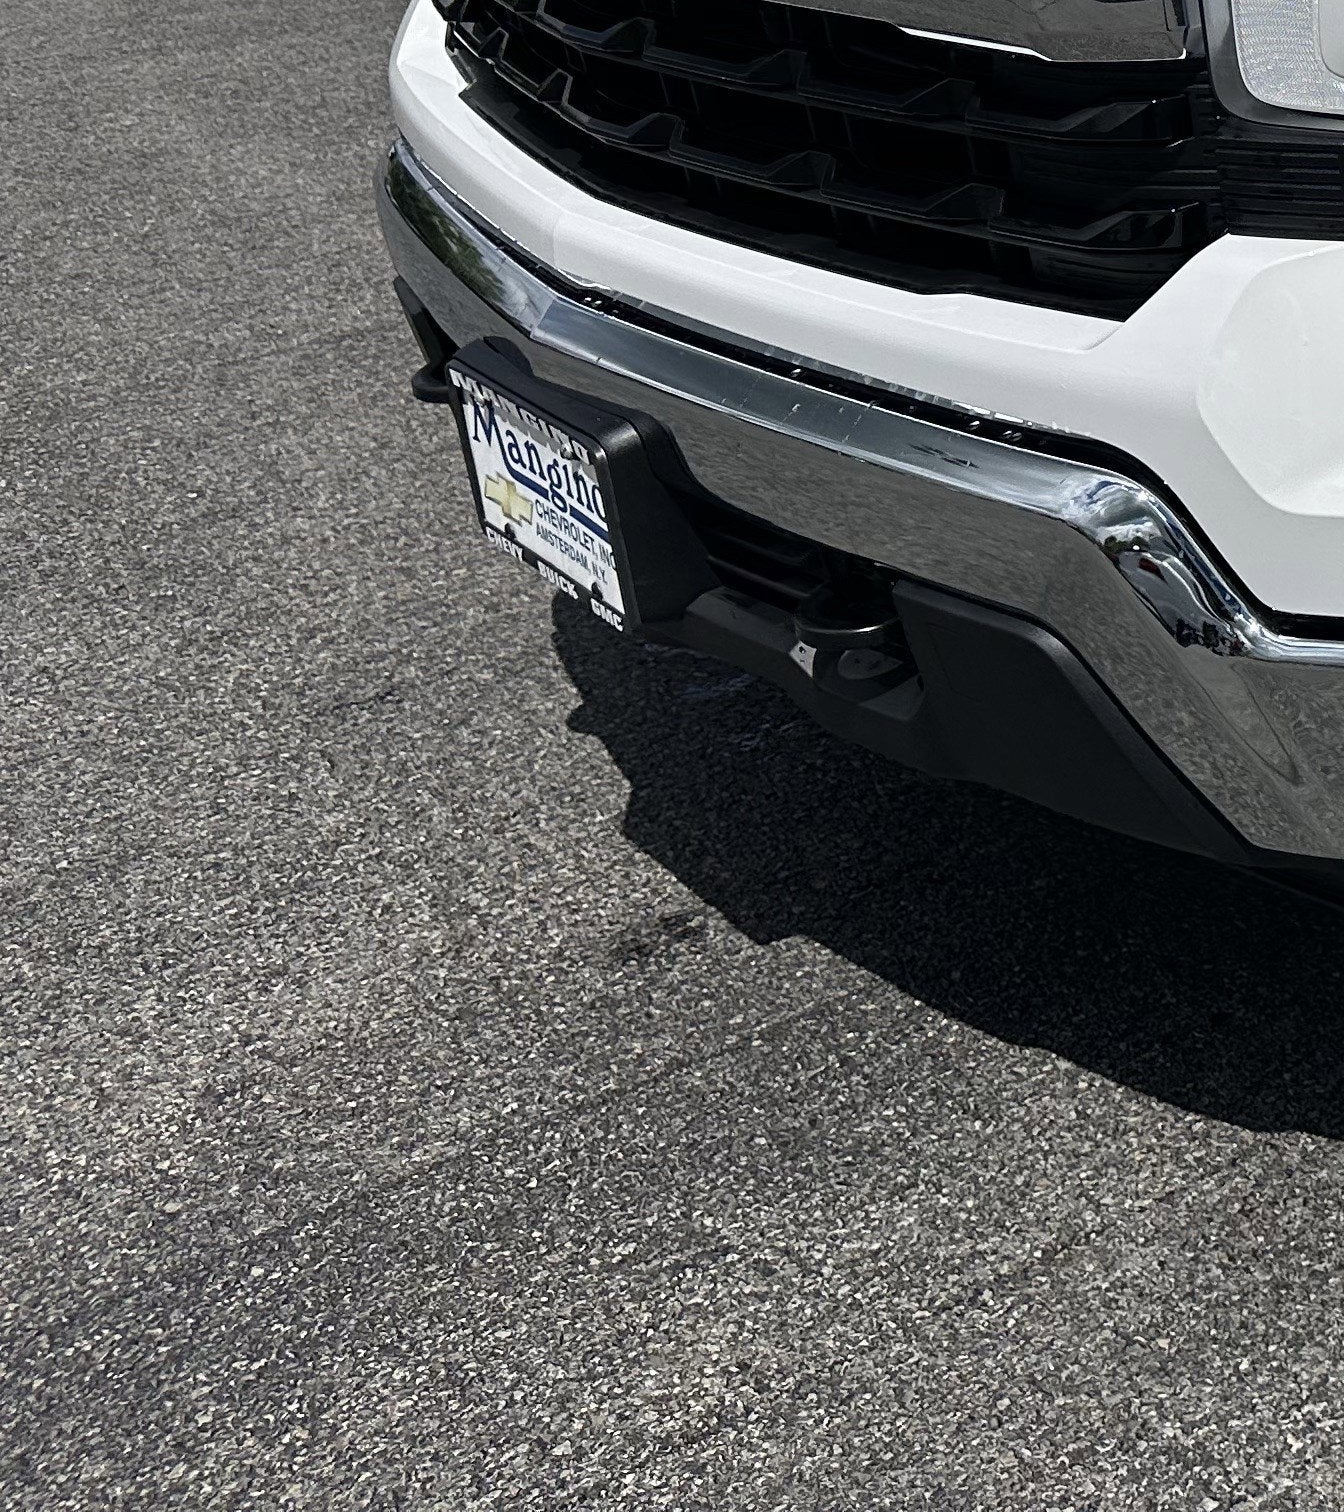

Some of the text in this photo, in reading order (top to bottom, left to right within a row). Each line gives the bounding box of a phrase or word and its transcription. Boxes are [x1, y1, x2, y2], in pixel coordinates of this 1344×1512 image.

[473, 399, 607, 519] Mangino
[486, 526, 623, 632] CHEVY BUICK GMC
